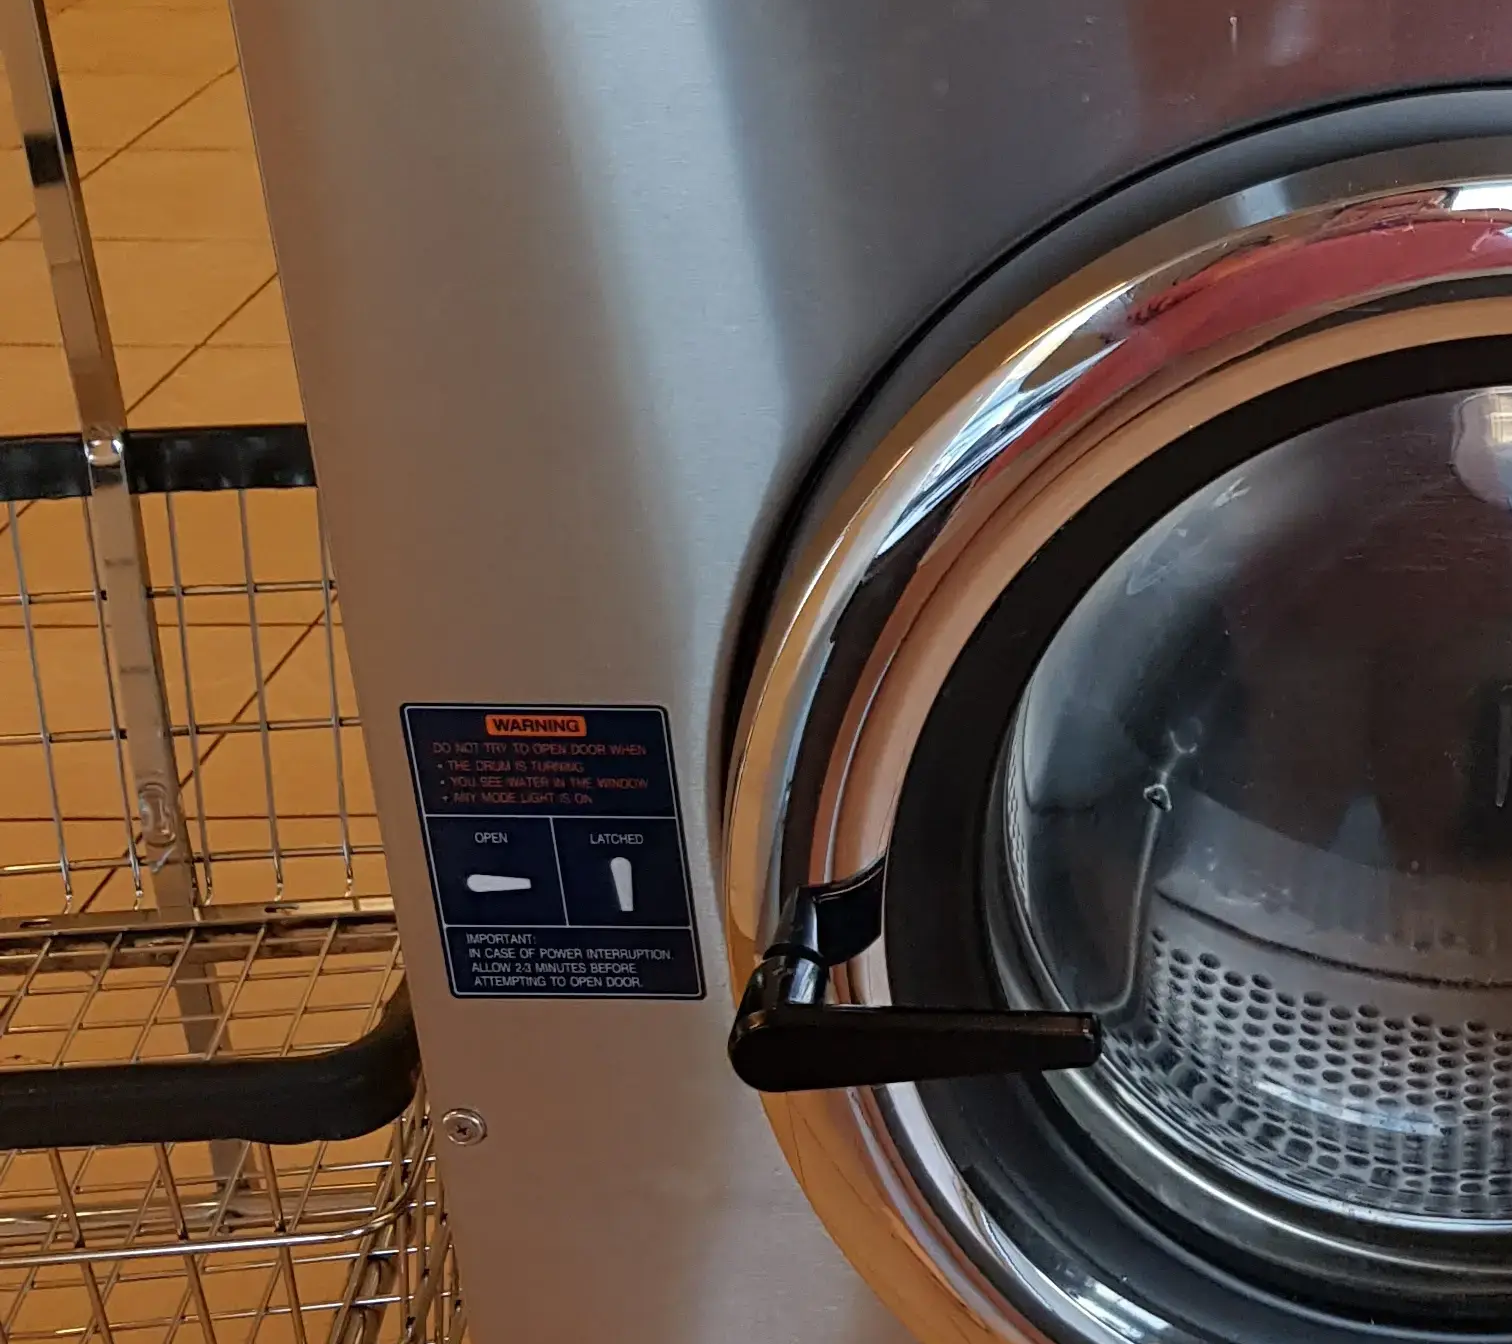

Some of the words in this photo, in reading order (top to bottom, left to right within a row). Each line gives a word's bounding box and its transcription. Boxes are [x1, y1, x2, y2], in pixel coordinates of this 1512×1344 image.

[493, 719, 580, 733] WARNING
[433, 743, 451, 755] DO
[456, 743, 479, 755] NOT
[484, 743, 507, 755] TRY
[513, 743, 529, 755] TO
[532, 743, 567, 755] OPEN
[571, 744, 605, 756] DOOR
[609, 744, 647, 756] WHEN
[448, 760, 470, 772] THE
[476, 760, 511, 772] DRUM
[515, 760, 527, 772] IS
[532, 761, 584, 773] TURNING
[450, 776, 476, 788] YOU
[481, 776, 502, 788] SEE
[507, 777, 548, 789] WATER
[553, 777, 565, 789] IN
[570, 777, 593, 789] THE
[597, 777, 648, 789] WINDOW
[453, 792, 476, 804] ANY
[481, 792, 518, 804] MODE
[521, 792, 553, 804] LIGHT
[560, 793, 571, 804] IS
[575, 793, 593, 805] ON
[474, 832, 509, 844] OPEN
[589, 833, 644, 845] LATCHED
[466, 933, 536, 945] IMPORTANT:
[468, 948, 481, 958] IN
[485, 948, 516, 959] CASE
[519, 948, 534, 959] OF
[540, 948, 583, 959] POWER
[472, 962, 511, 973] ALLOW
[515, 962, 532, 974] 2-3
[535, 962, 586, 974] MINUTES
[590, 963, 637, 974] BEFORE
[474, 976, 546, 987] ATTEMPTING
[551, 976, 565, 987] TO
[570, 977, 602, 987] OPEN
[606, 977, 643, 988] DOOR.
